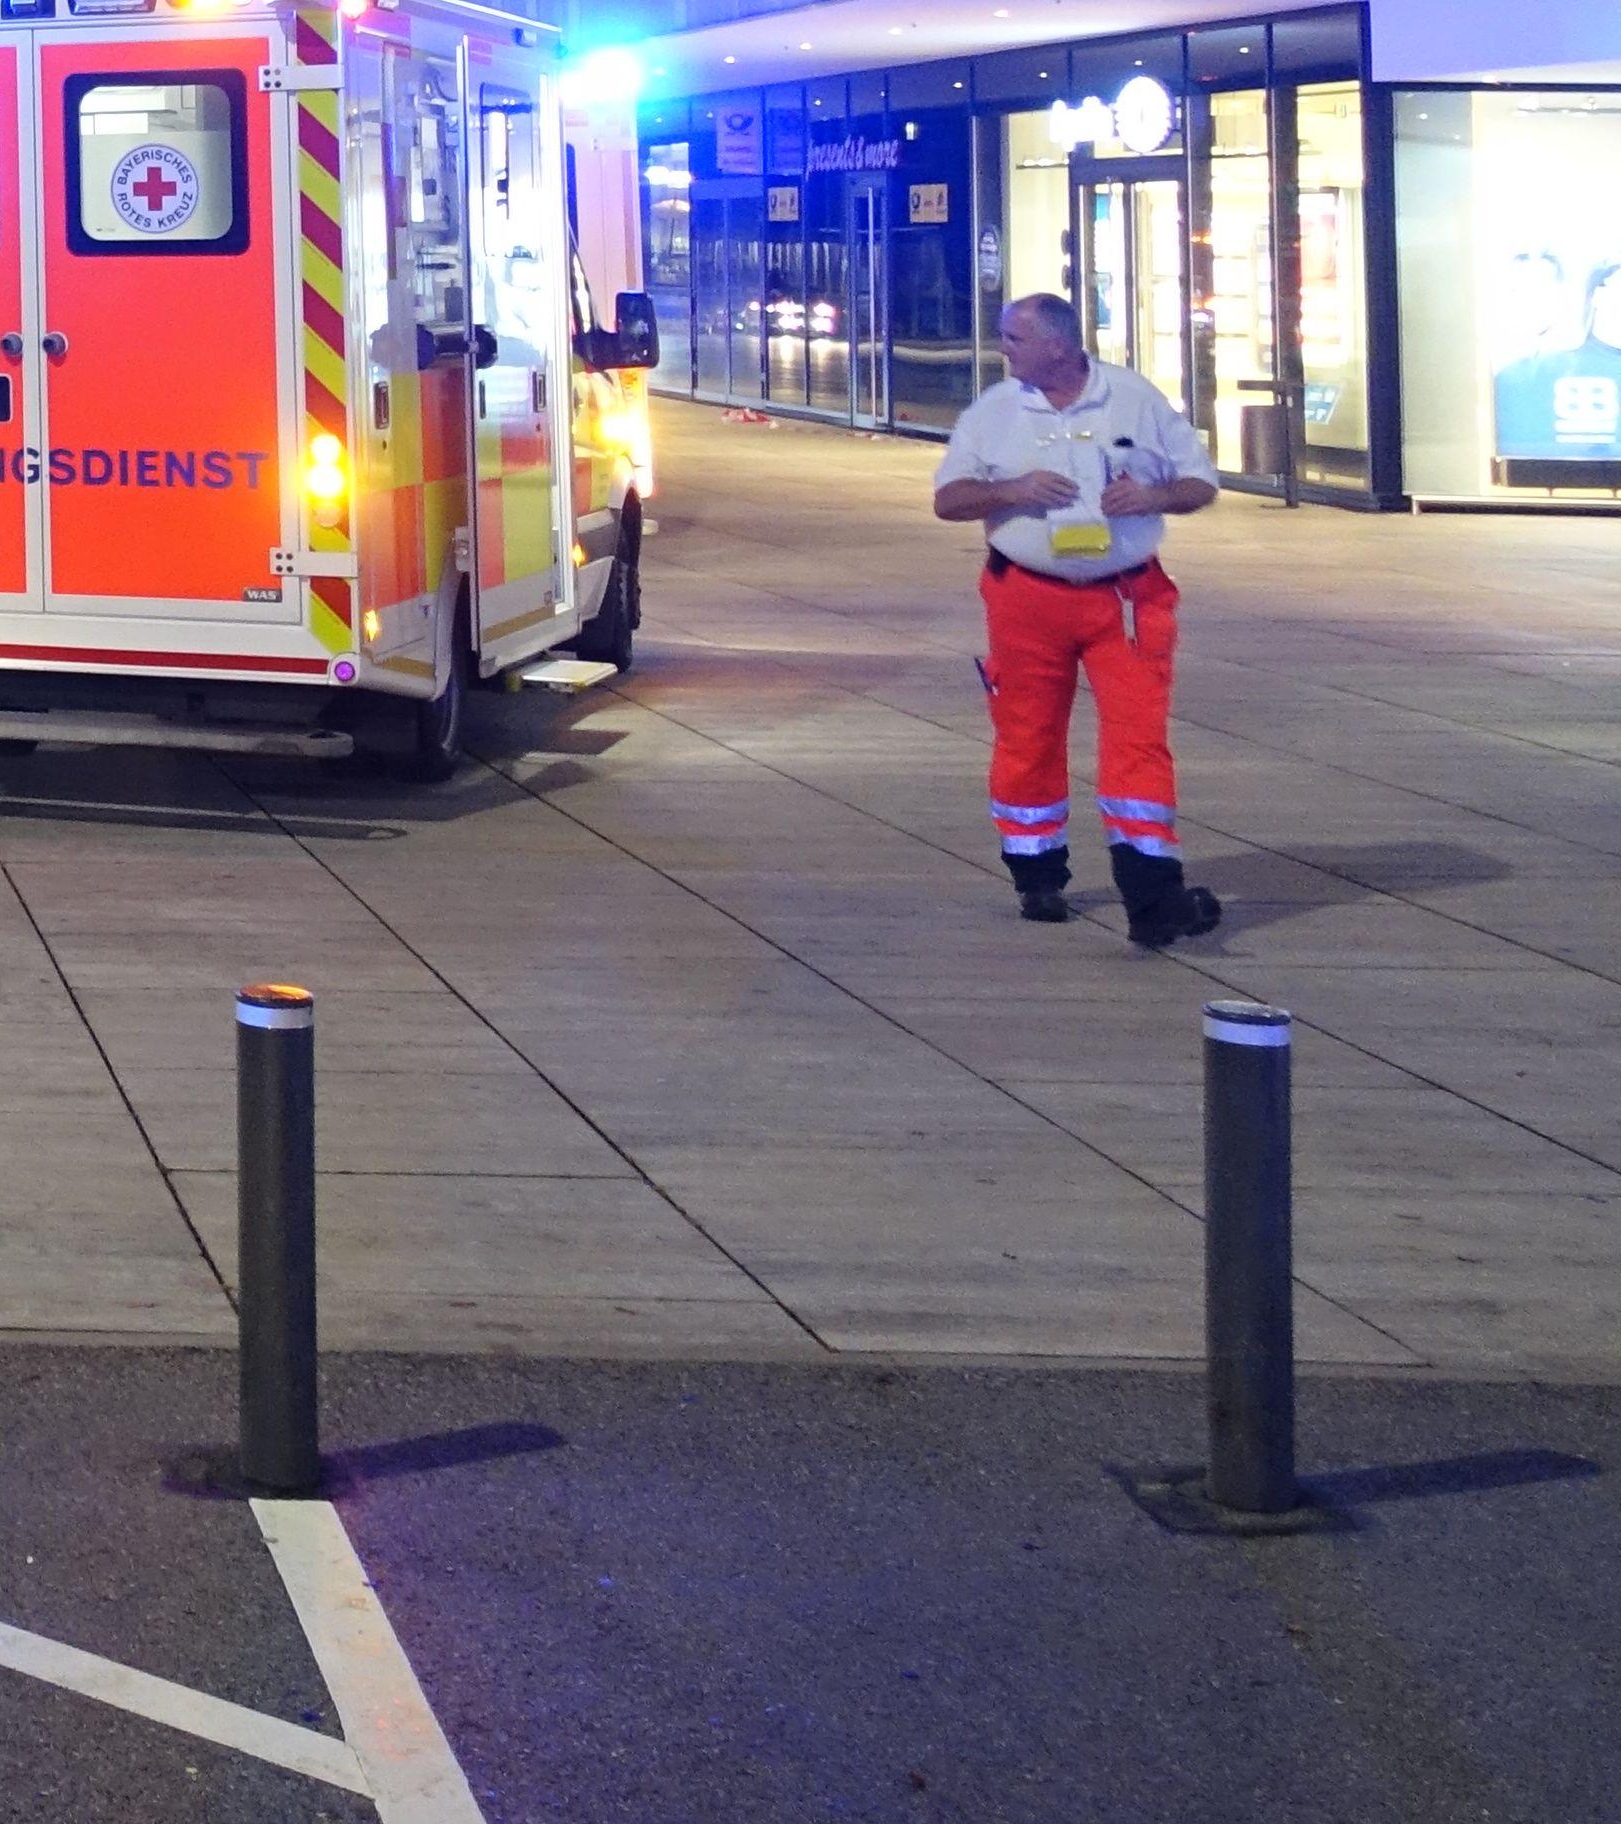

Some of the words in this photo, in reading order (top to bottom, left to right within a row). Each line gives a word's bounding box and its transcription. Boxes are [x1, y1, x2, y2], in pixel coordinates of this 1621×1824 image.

[116, 150, 192, 185] BAYERISCHES
[117, 192, 152, 228] ROTES
[157, 191, 193, 228] KREUZ
[247, 588, 278, 601] WAS
